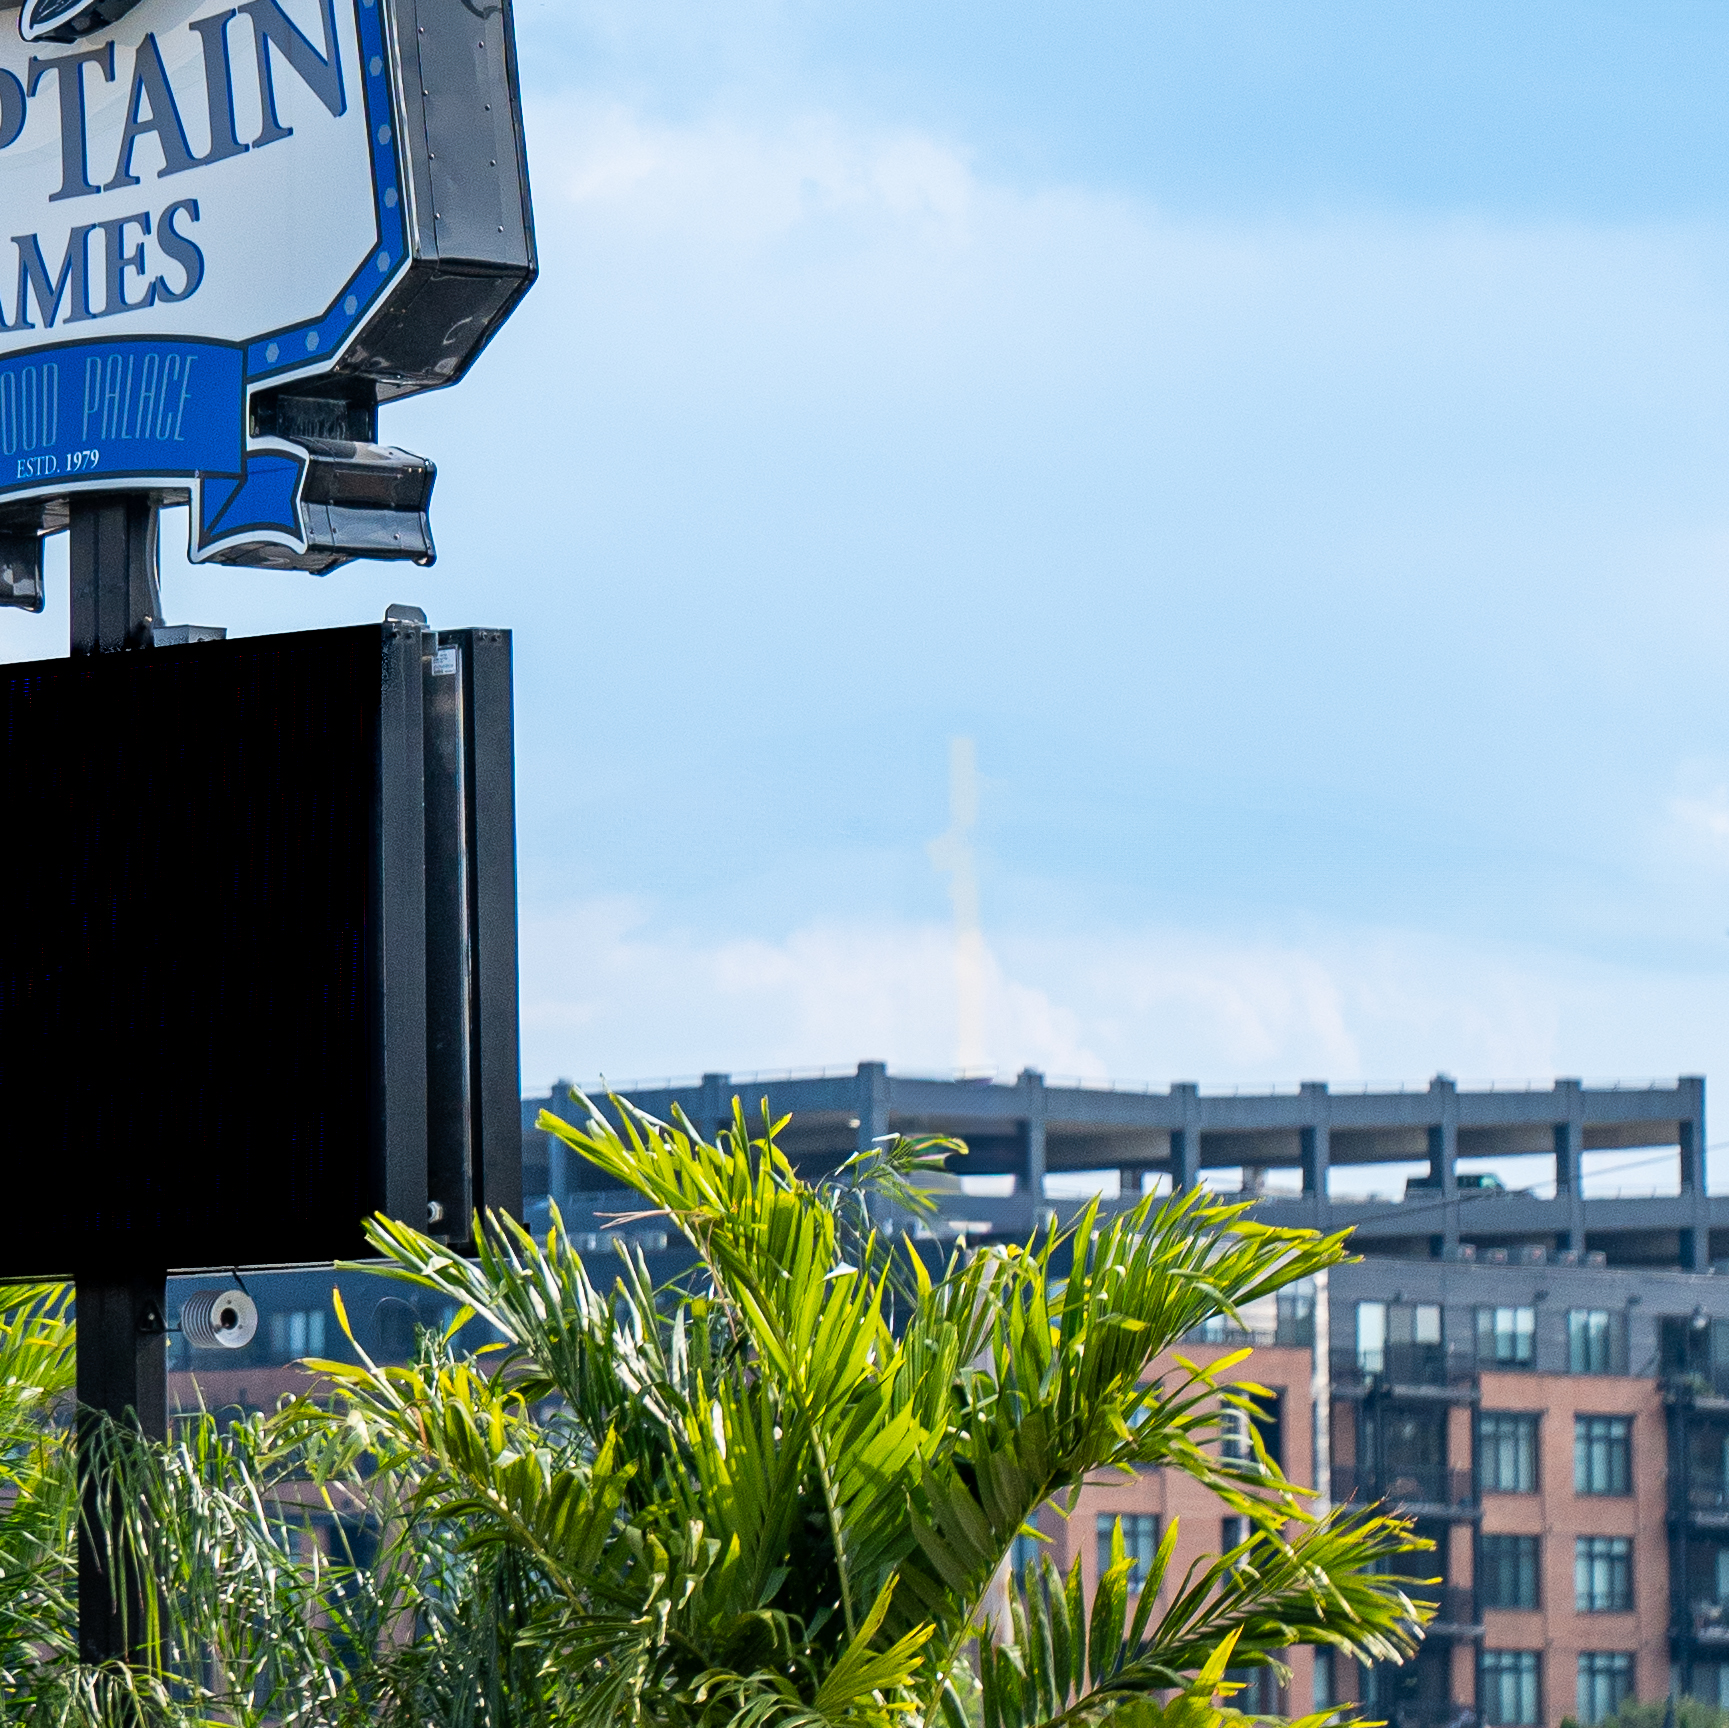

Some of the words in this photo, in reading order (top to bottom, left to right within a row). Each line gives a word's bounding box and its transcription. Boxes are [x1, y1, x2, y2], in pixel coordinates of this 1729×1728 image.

[82, 353, 199, 442] PALACE
[16, 455, 61, 479] ESTD.
[65, 449, 100, 473] 1979
